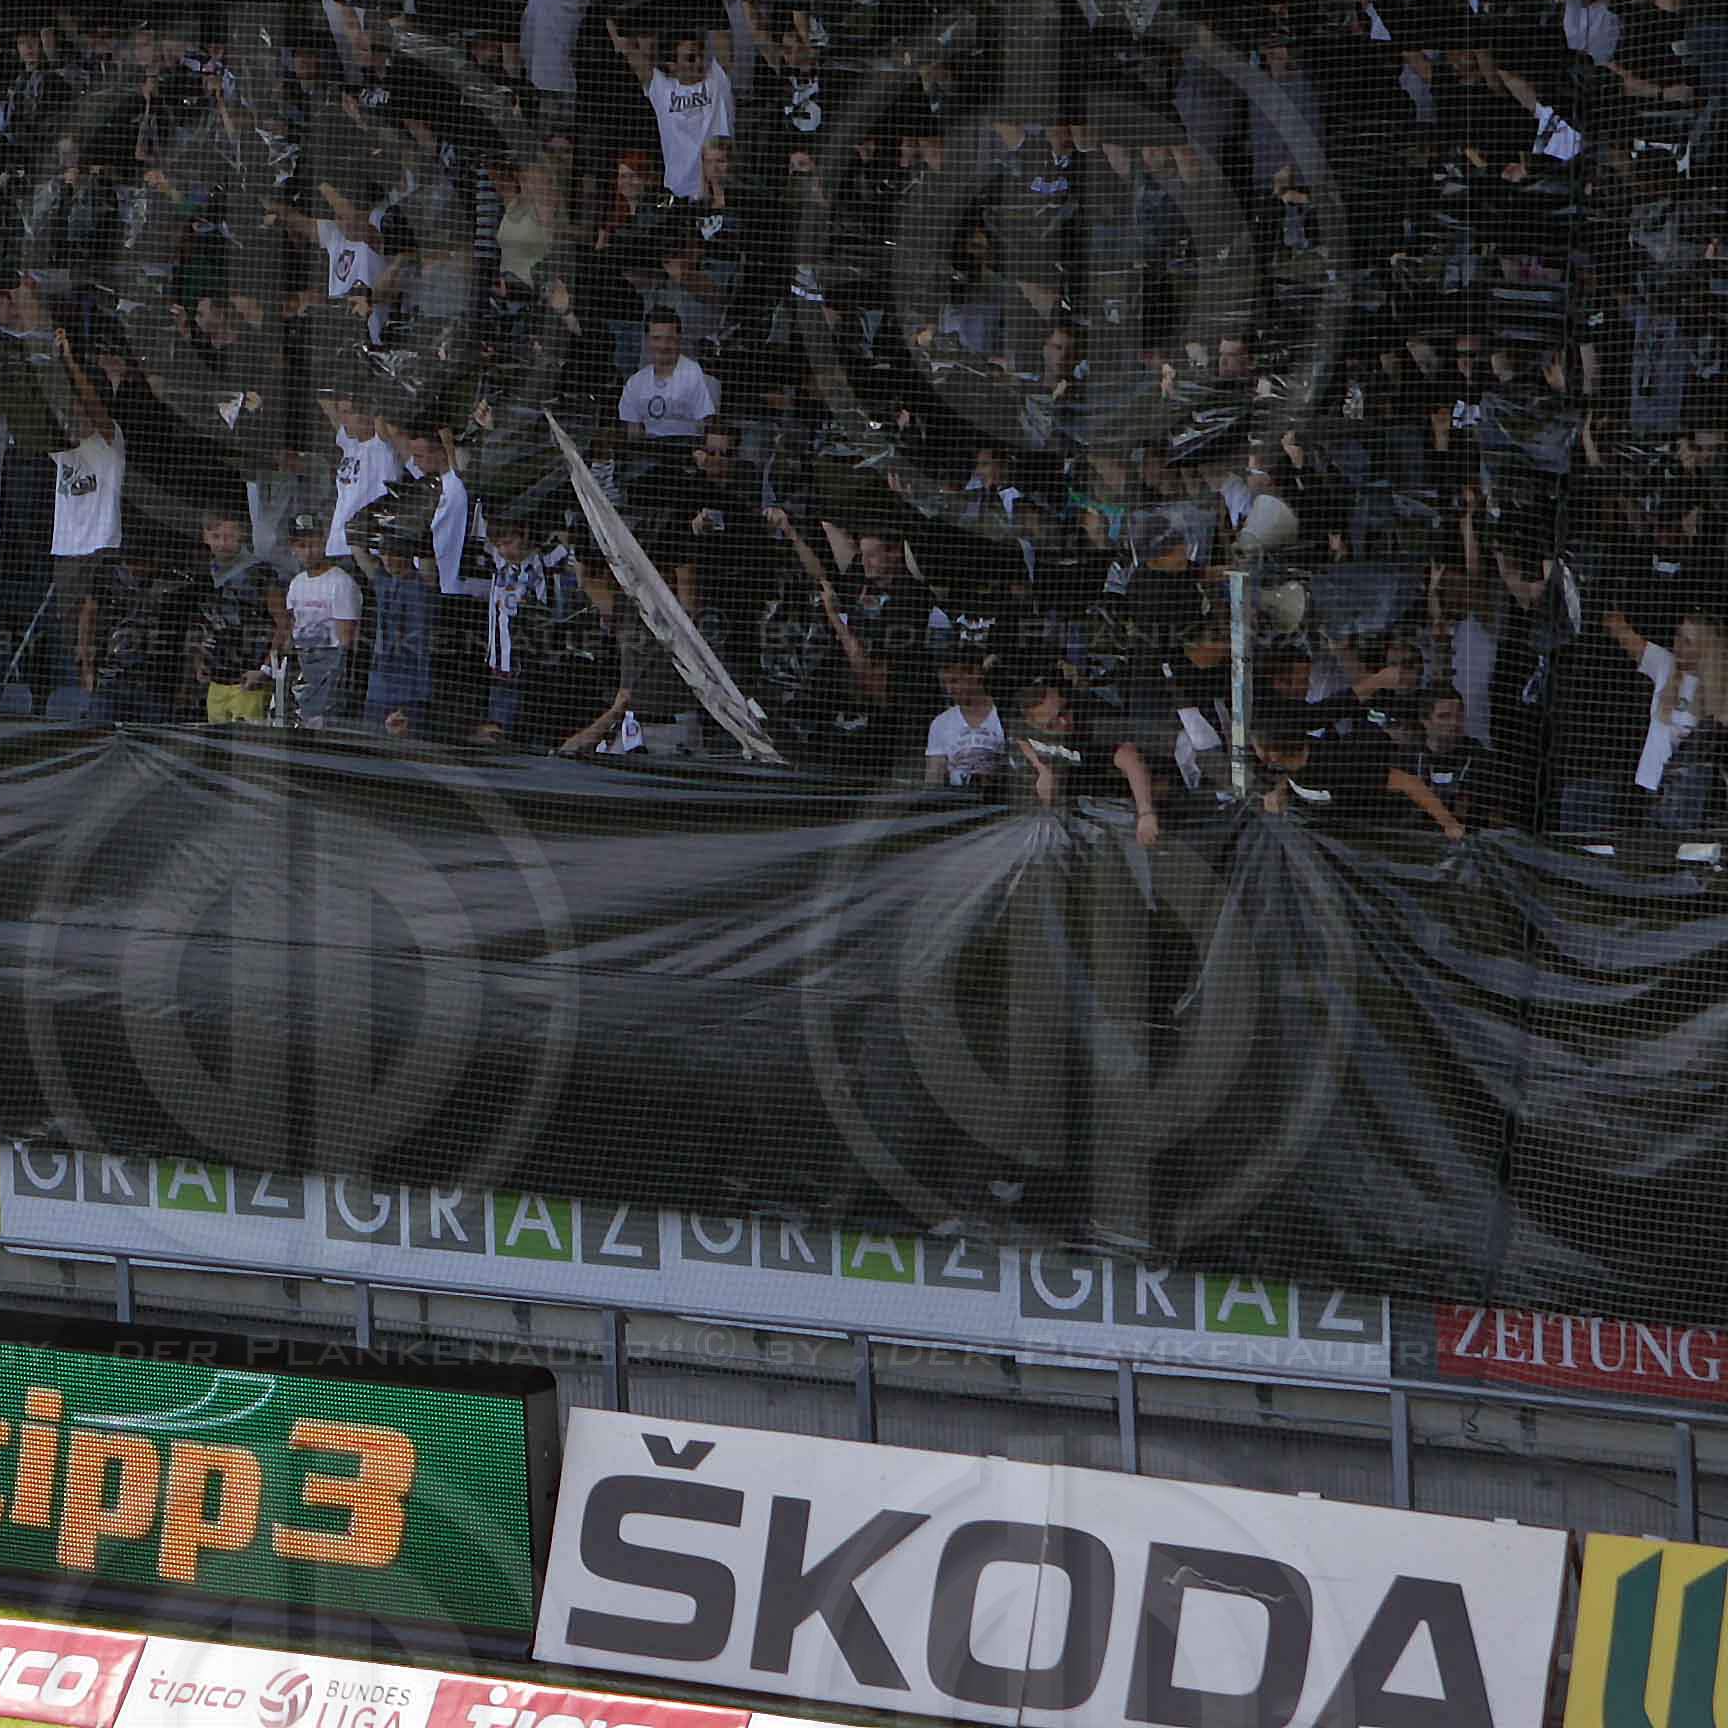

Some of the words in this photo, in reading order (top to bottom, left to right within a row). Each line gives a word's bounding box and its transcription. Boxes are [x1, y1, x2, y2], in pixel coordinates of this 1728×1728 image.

[1452, 1302, 1722, 1382] ZEITUNG
[565, 1432, 1496, 1728] ŠKODA
[148, 1668, 246, 1711] tipico
[325, 1680, 413, 1708] BUNDES
